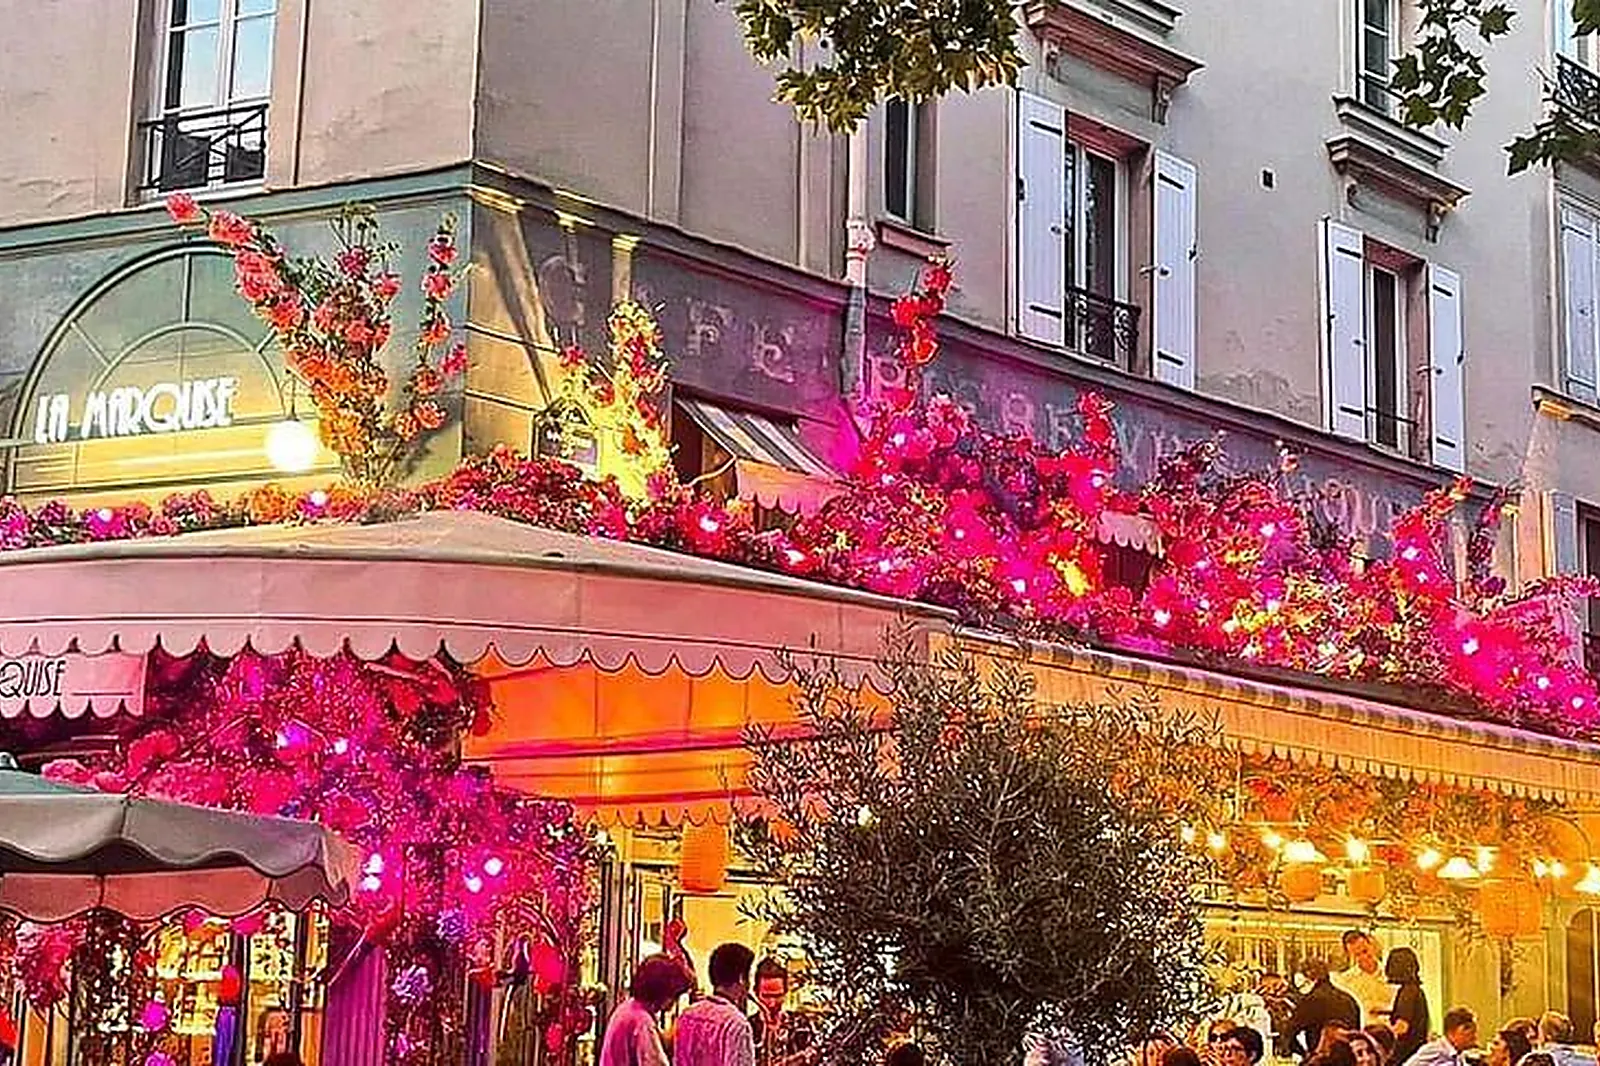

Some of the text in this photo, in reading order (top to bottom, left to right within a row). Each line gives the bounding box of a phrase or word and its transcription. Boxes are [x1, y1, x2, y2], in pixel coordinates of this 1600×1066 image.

[539, 253, 798, 385] CFE
[34, 376, 238, 443] LA MARQUISE
